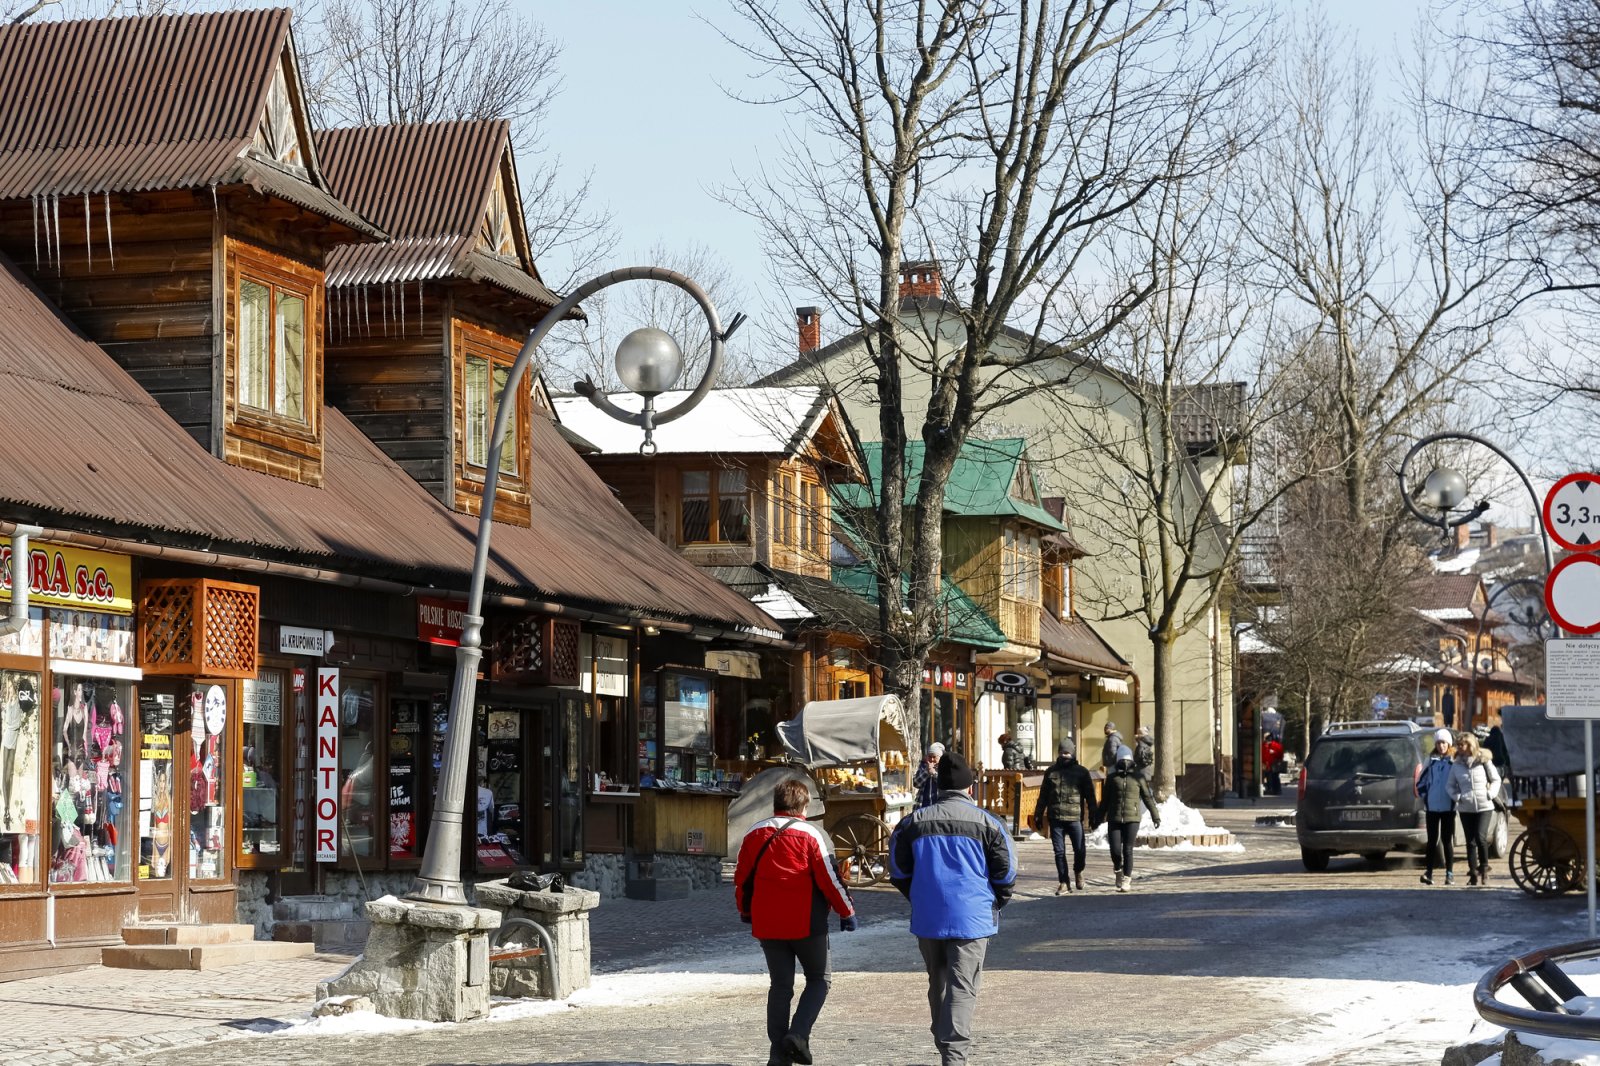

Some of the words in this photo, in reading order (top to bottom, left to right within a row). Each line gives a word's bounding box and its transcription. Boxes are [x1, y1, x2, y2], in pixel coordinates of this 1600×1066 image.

[1556, 503, 1590, 527] 3,3
[420, 604, 444, 627] POLSKIE
[288, 632, 315, 651] KRUPÓWKI
[317, 674, 338, 852] KANTOR
